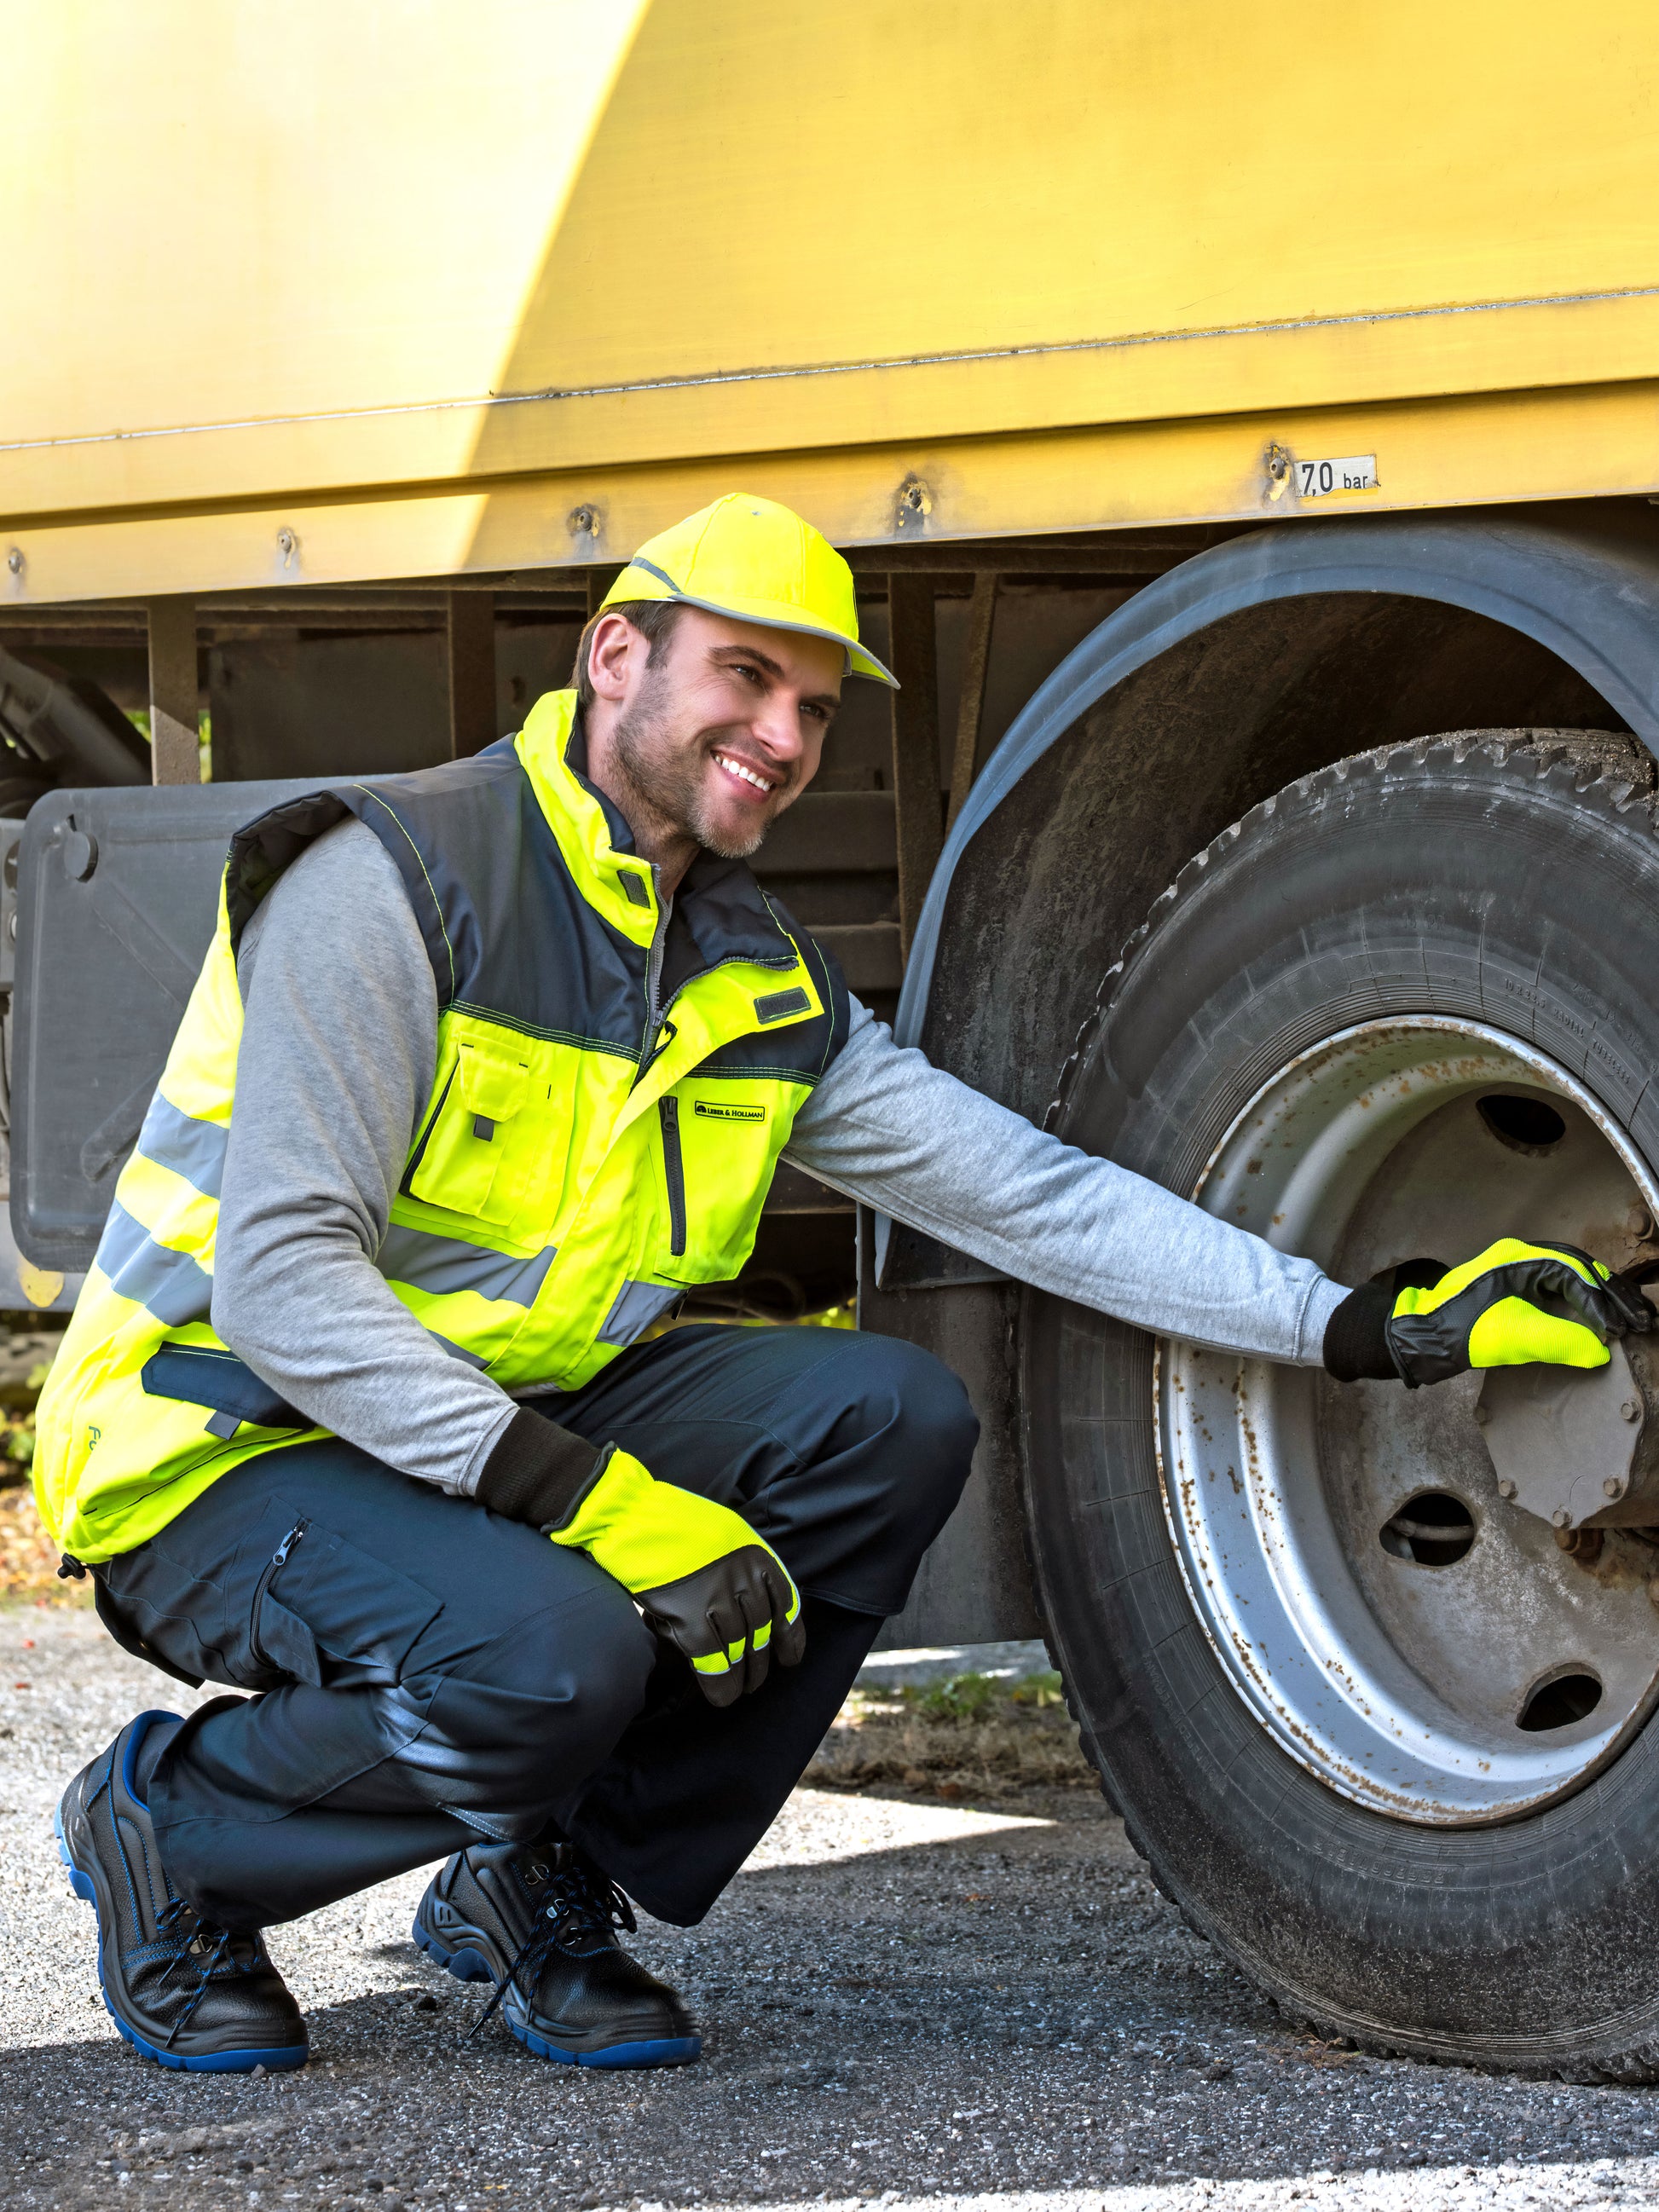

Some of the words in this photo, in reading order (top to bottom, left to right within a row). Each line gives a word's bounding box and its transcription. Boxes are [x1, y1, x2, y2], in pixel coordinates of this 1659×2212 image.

[1302, 461, 1333, 496] 7,0
[1344, 473, 1367, 489] bar
[708, 1107, 725, 1116] LEBER
[731, 1110, 762, 1118] HOLLMAN
